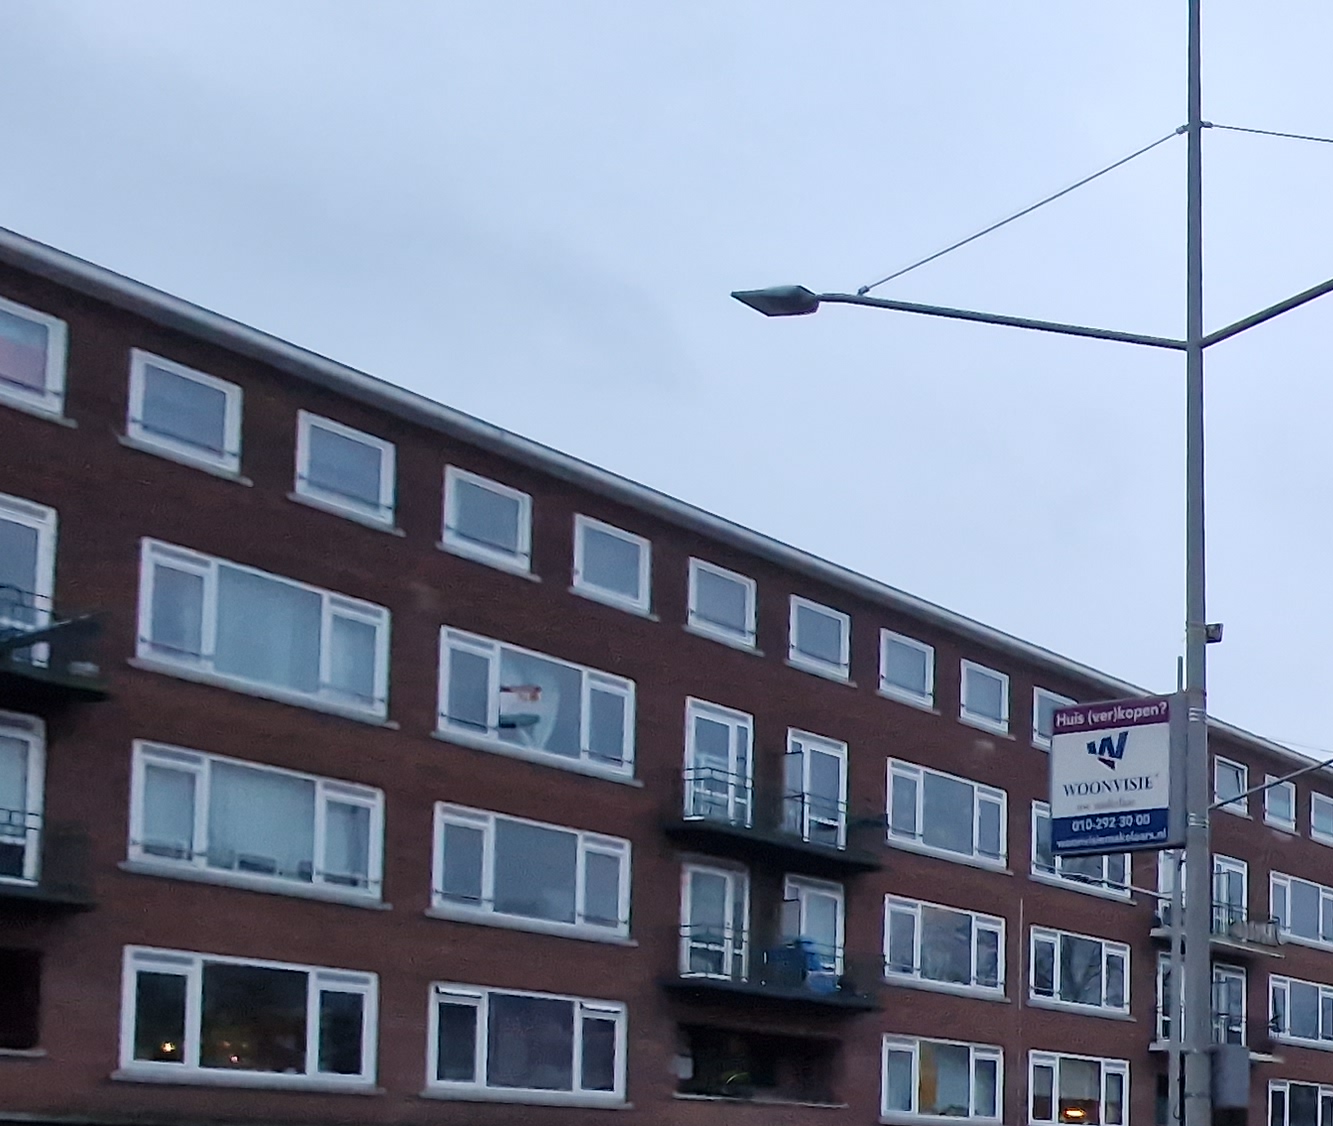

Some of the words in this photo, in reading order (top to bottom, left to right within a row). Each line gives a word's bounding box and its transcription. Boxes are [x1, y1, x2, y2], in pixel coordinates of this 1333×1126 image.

[1056, 712, 1085, 728] Huis
[1088, 701, 1167, 726] (ver)kopen?
[1063, 776, 1153, 797] WOONVISIE
